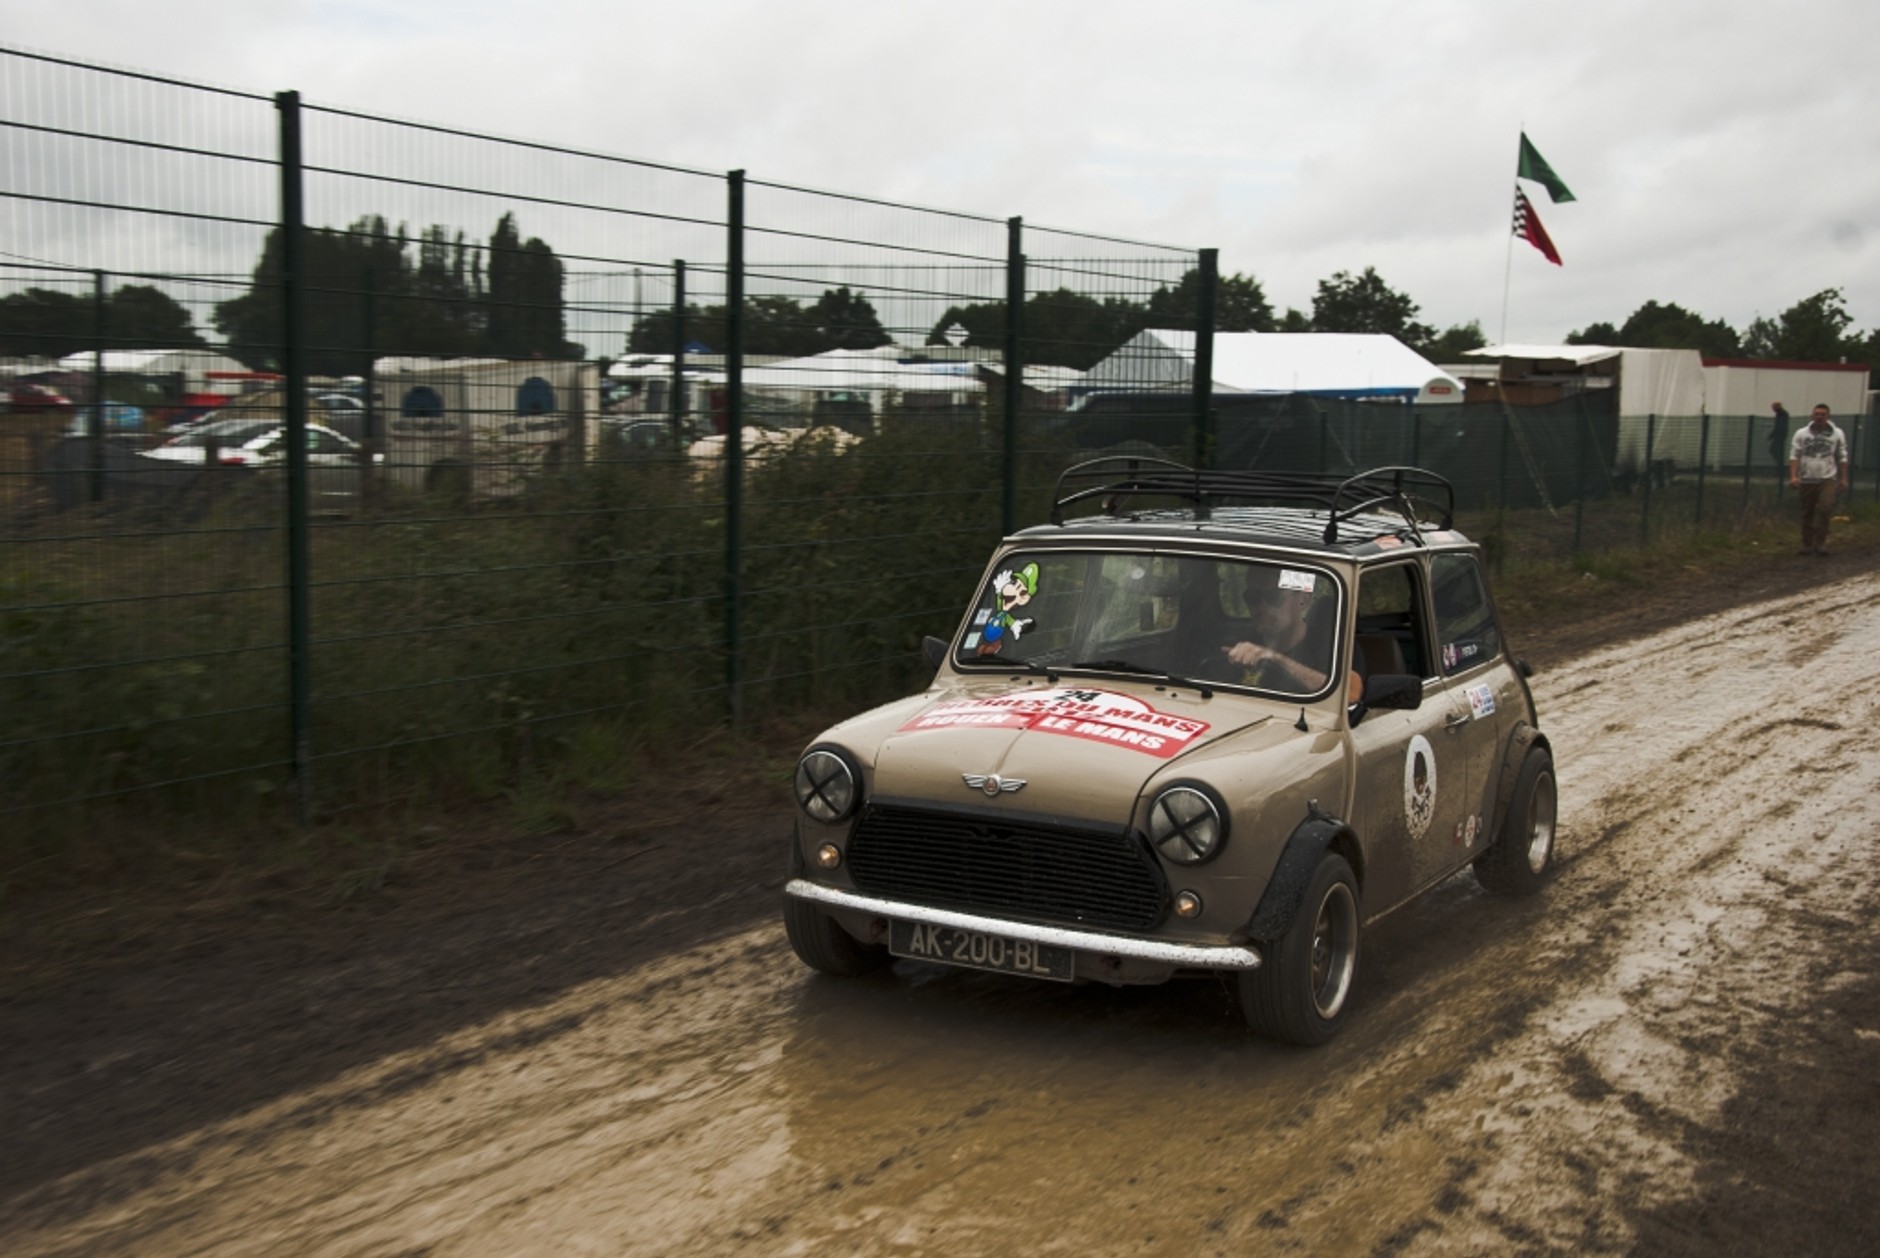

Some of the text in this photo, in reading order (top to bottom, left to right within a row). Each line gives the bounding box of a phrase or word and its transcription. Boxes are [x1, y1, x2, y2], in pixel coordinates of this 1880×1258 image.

[1039, 716, 1070, 730] LE
[1074, 722, 1167, 750] MANS
[1055, 701, 1101, 712] DU
[1104, 707, 1199, 733] MANS
[910, 924, 1050, 973] AK-200-BL
